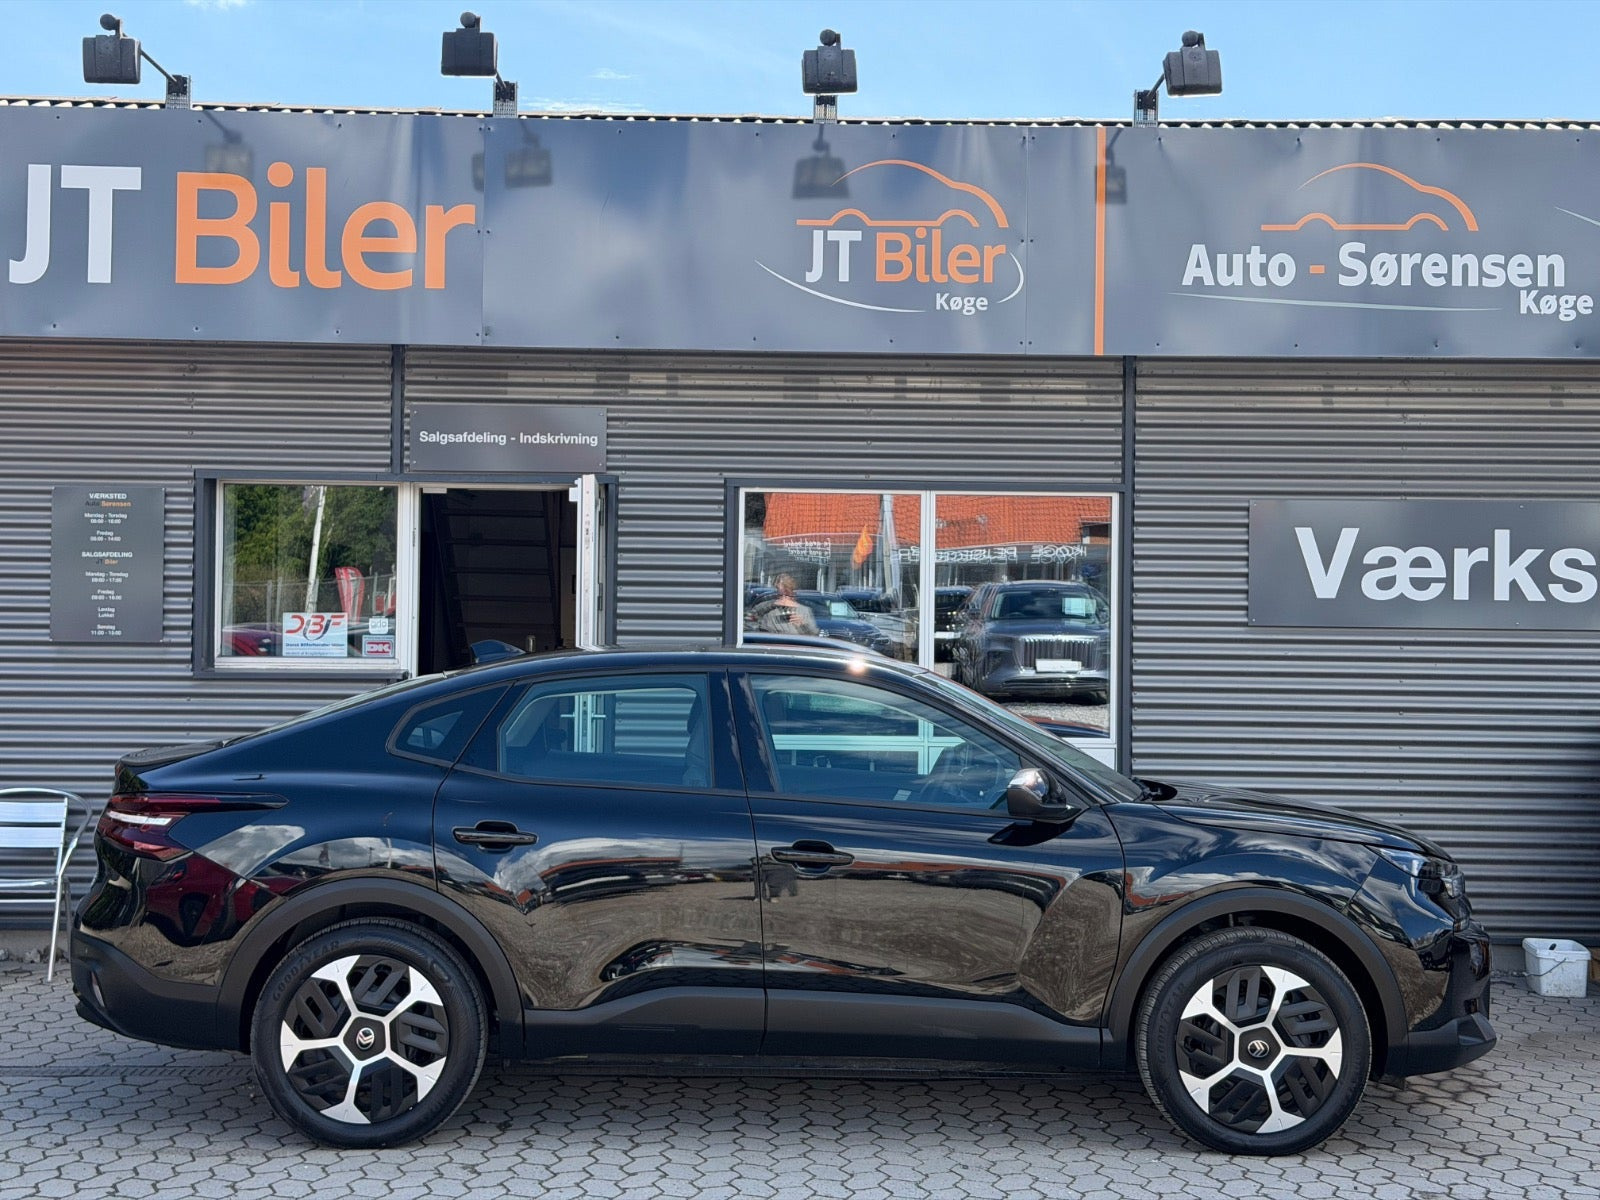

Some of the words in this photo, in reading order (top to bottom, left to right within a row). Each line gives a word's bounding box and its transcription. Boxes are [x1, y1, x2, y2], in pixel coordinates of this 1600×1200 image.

[8, 163, 142, 285] JT
[174, 161, 476, 290] Biler
[805, 229, 862, 283] JT
[875, 226, 1006, 284] Biler
[1182, 243, 1297, 287] Auto
[1309, 264, 1325, 274] -
[1337, 241, 1566, 288] Sørensen
[935, 292, 989, 315] Køge
[1519, 289, 1594, 321] Køge
[419, 430, 507, 446] Salgsafdeling
[519, 431, 599, 447] Indskrivning
[1294, 526, 1599, 604] Værks
